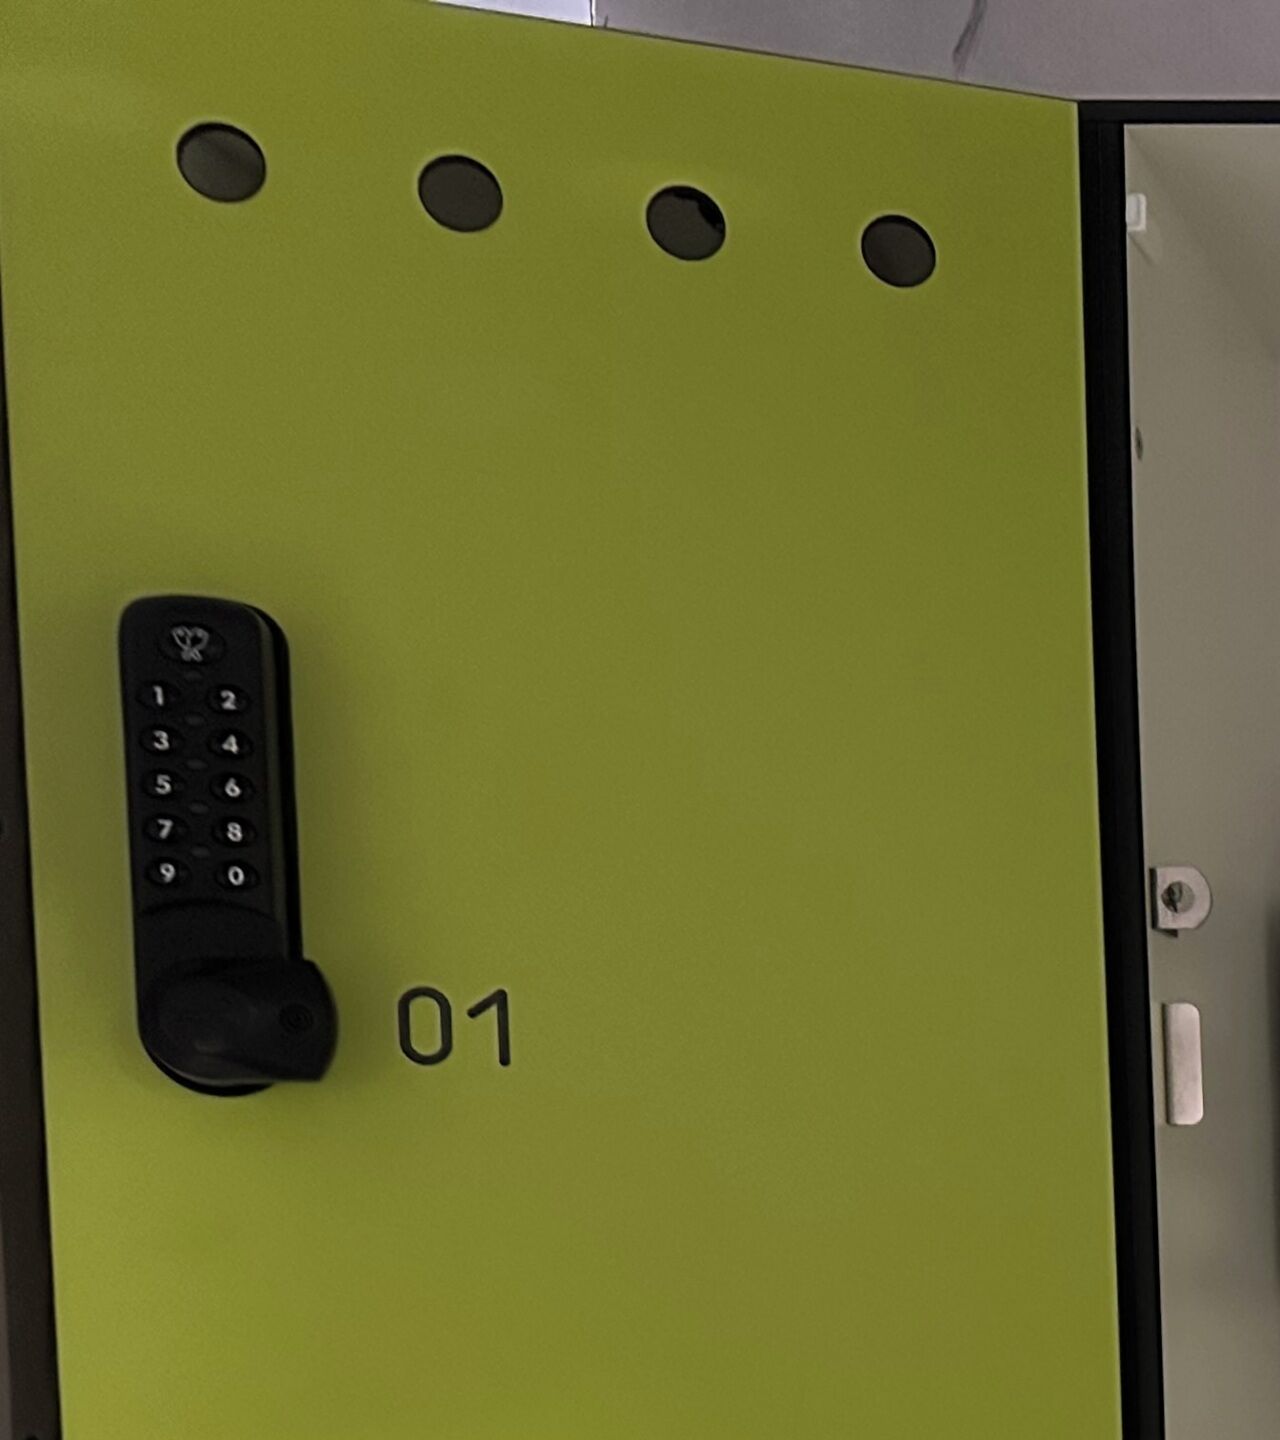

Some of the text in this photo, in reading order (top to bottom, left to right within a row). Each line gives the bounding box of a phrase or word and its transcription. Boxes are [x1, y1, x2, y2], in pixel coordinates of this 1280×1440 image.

[154, 686, 236, 710] 1 2
[153, 730, 239, 754] 3 4
[155, 775, 241, 797] 5 6
[158, 819, 243, 842] 7 8
[160, 863, 245, 886] 9 0
[397, 985, 512, 1067] 01
